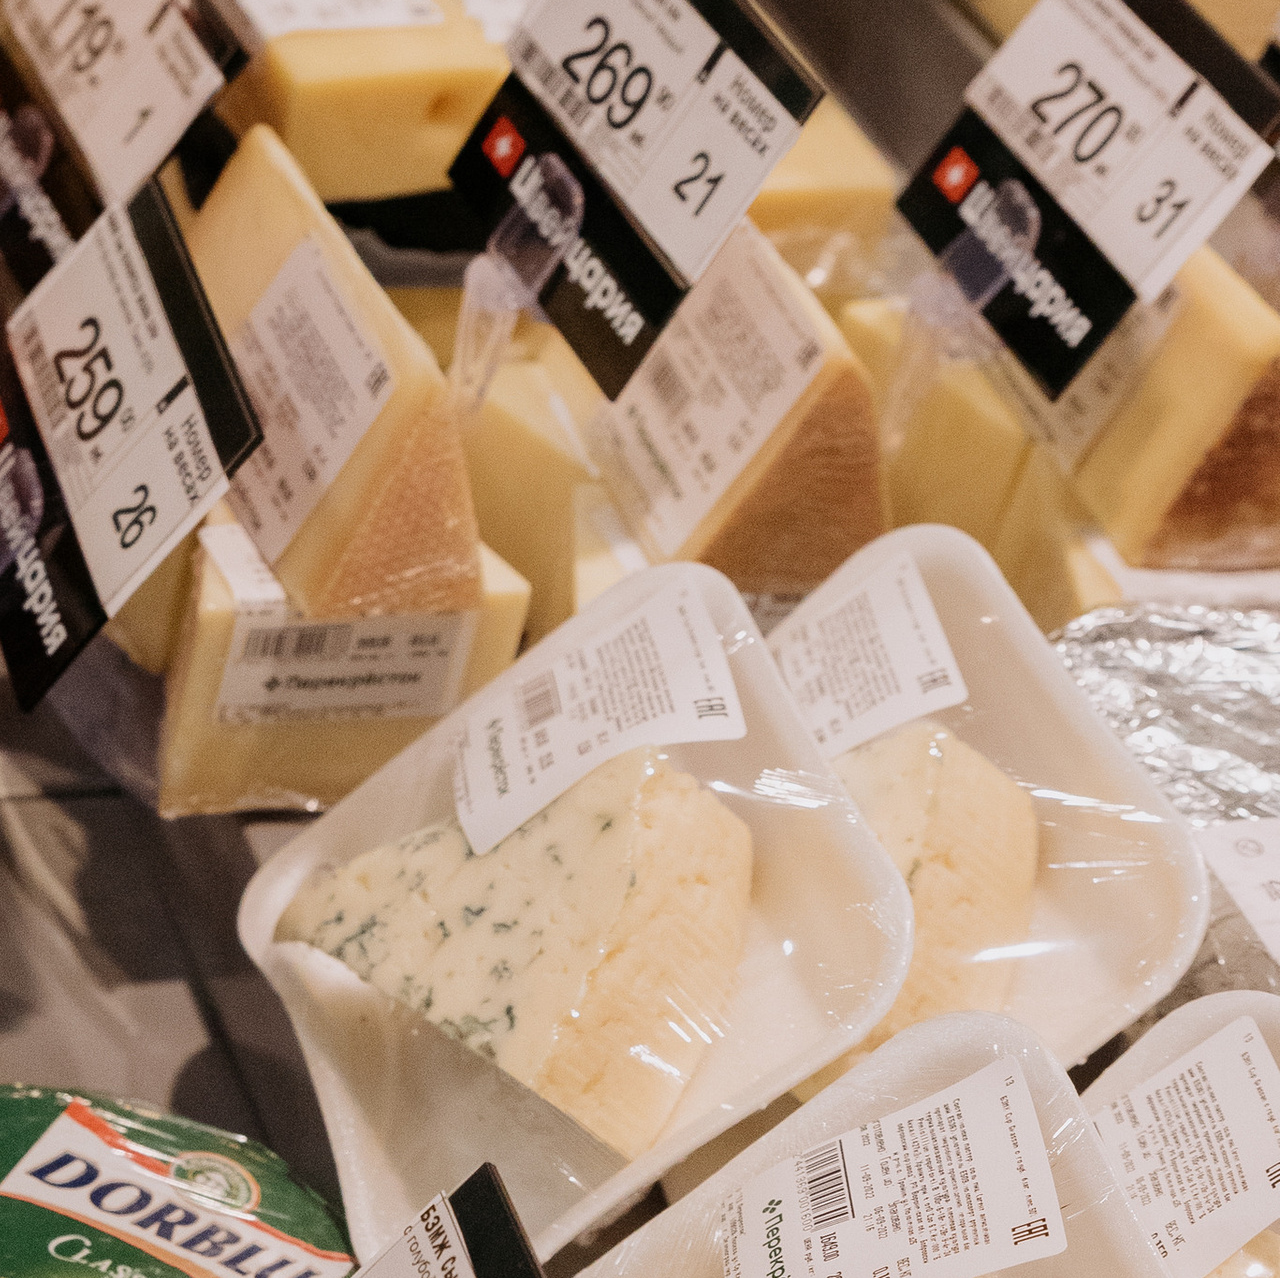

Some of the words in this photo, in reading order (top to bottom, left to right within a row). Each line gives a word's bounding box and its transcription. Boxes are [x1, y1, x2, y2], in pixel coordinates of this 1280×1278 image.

[560, 16, 654, 131] 269
[1028, 61, 1124, 165] 270
[672, 151, 724, 217] 21
[1136, 179, 1190, 239] 31
[32, 316, 125, 443] 259
[164, 427, 179, 452] на
[173, 450, 201, 507] весах
[181, 413, 213, 482] Номер
[111, 483, 157, 550] 26
[693, 696, 729, 720] EAC
[1004, 1075, 1015, 1087] 13
[860, 1164, 876, 1200] 11-09-2022
[420, 1204, 452, 1260] БЗМЖ
[798, 1195, 814, 1232] 001600
[873, 1205, 889, 1240] 06-09-2022
[1011, 1217, 1050, 1246] EAC
[819, 1231, 840, 1262] 1649.00
